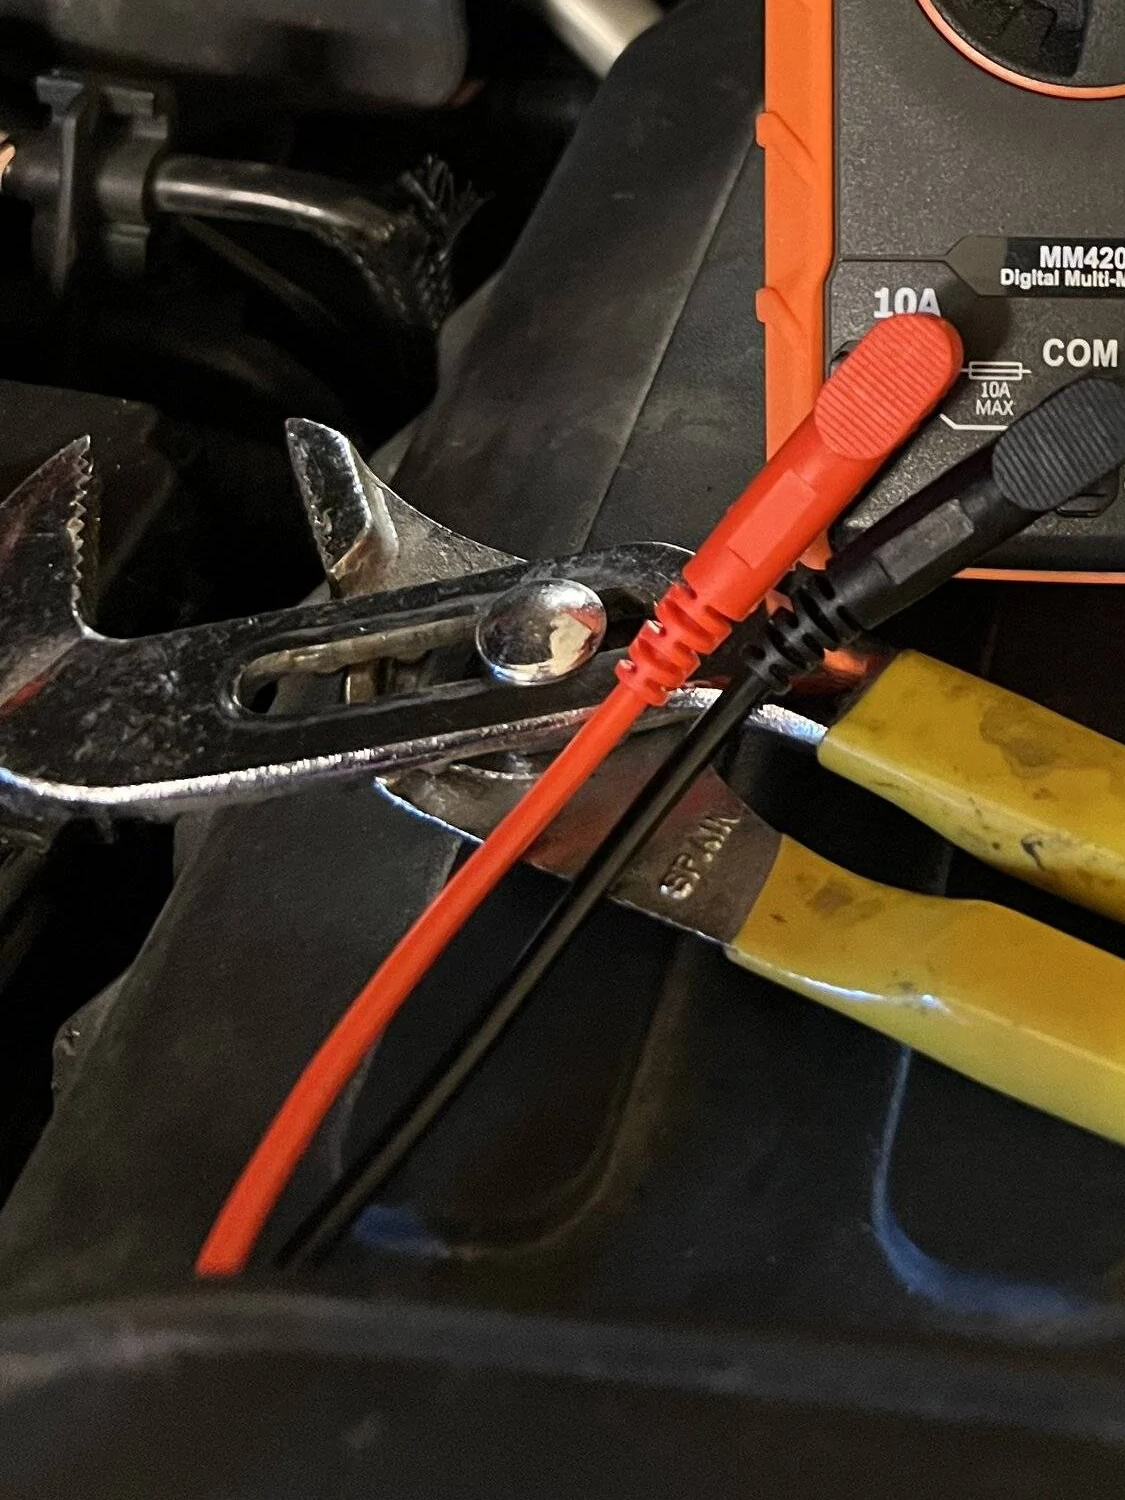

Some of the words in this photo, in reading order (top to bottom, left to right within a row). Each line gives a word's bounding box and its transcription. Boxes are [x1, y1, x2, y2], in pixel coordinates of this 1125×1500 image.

[1000, 268, 1059, 288] Digital
[873, 287, 941, 318] 10A
[1043, 338, 1119, 368] COM
[981, 382, 1011, 399] 10A
[975, 400, 1014, 416] MAX
